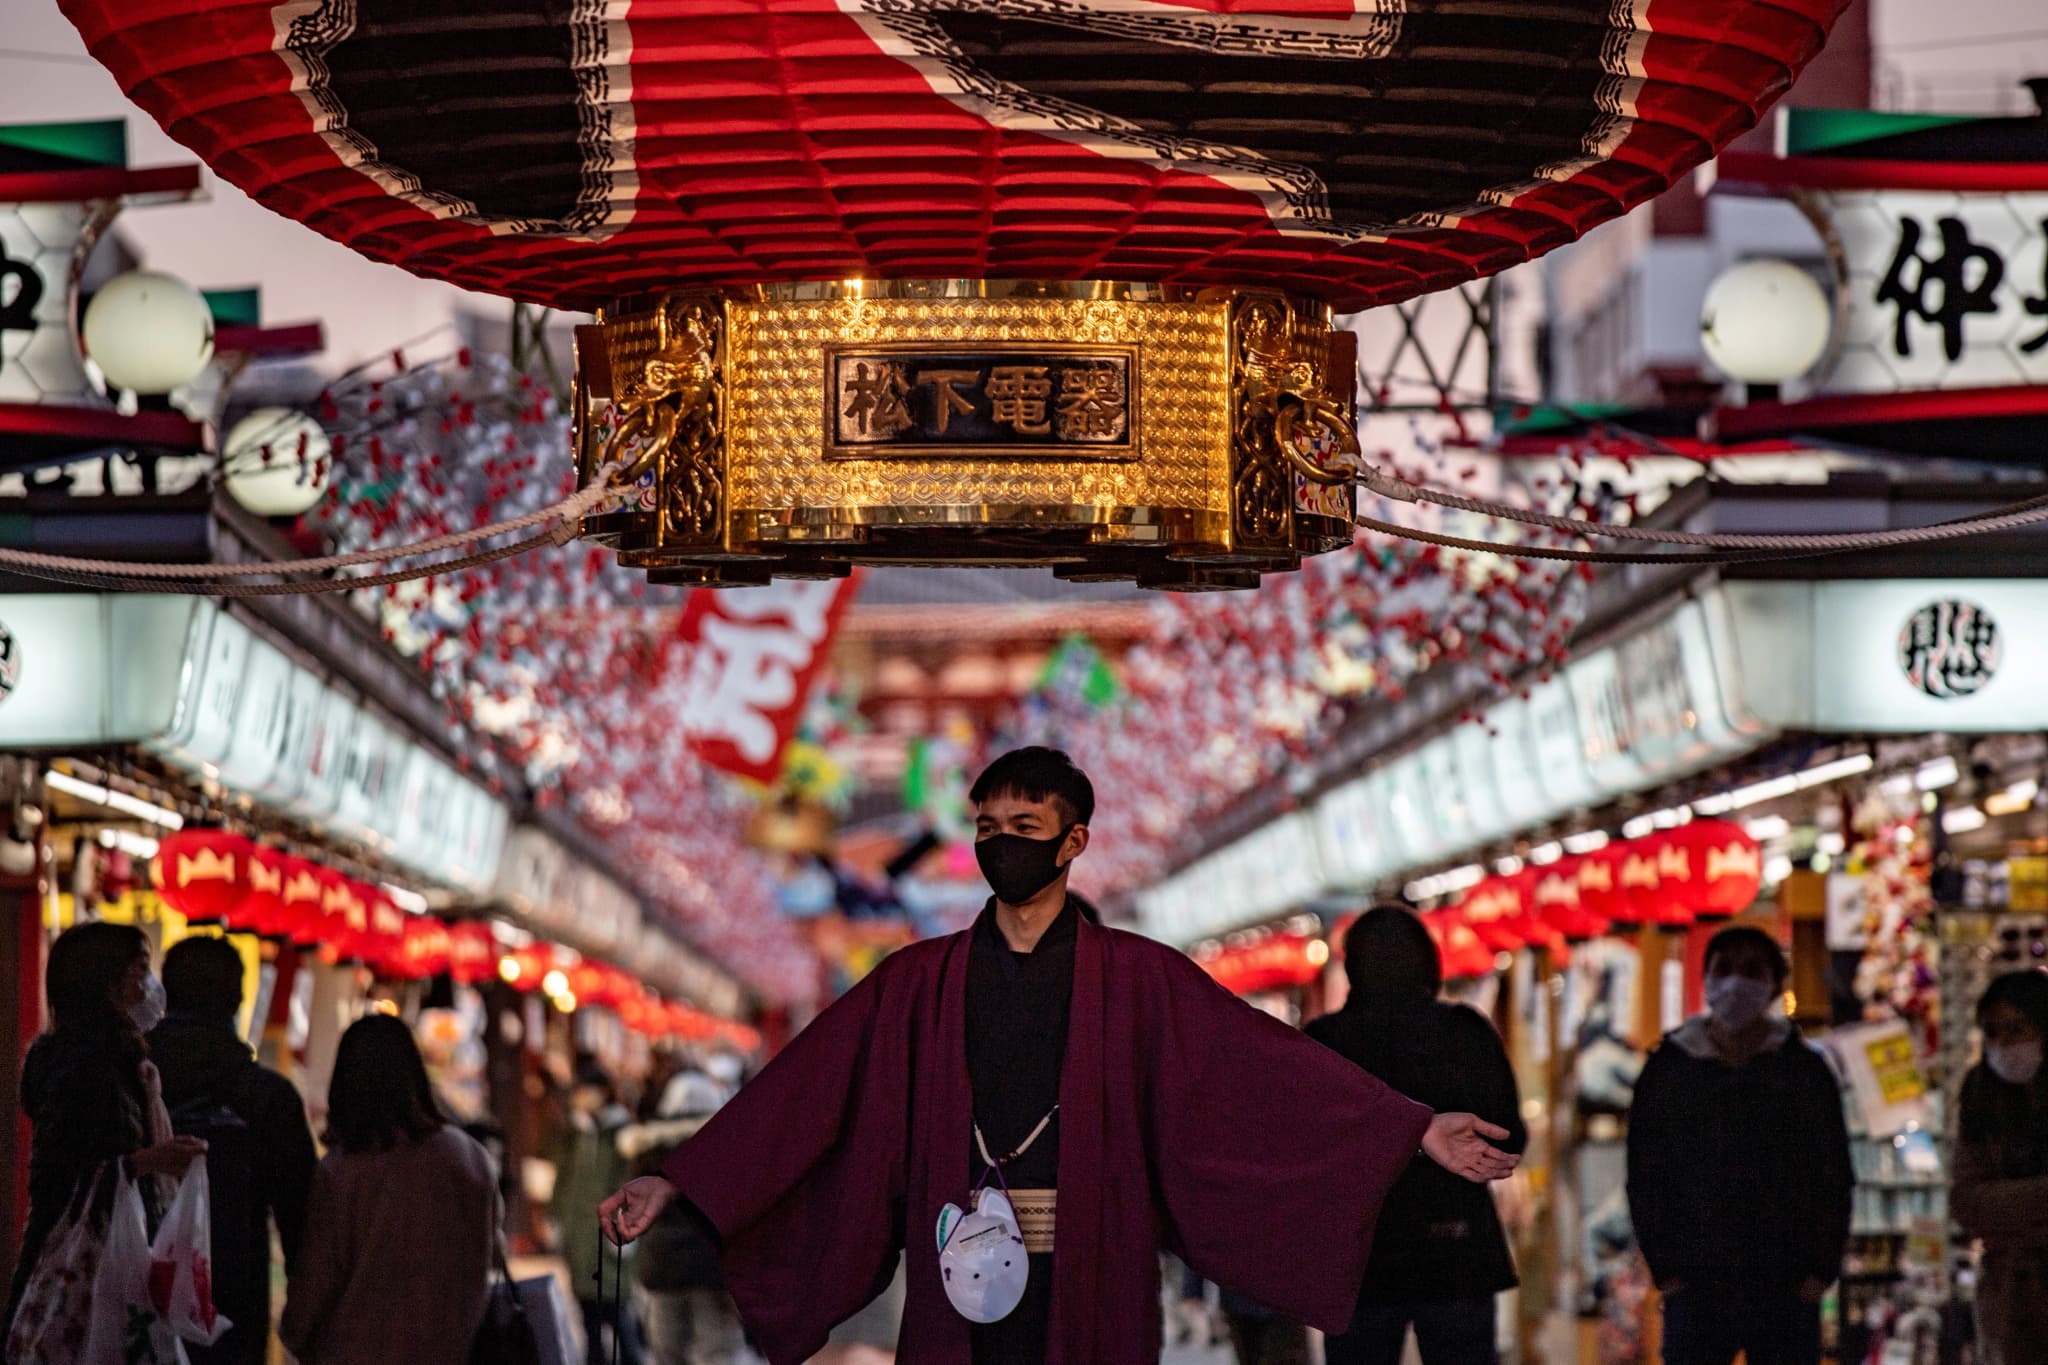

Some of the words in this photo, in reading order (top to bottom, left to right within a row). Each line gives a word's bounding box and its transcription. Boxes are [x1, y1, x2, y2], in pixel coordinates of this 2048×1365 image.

[1876, 216, 2048, 362] 仲
[843, 361, 1126, 436] 松下電器
